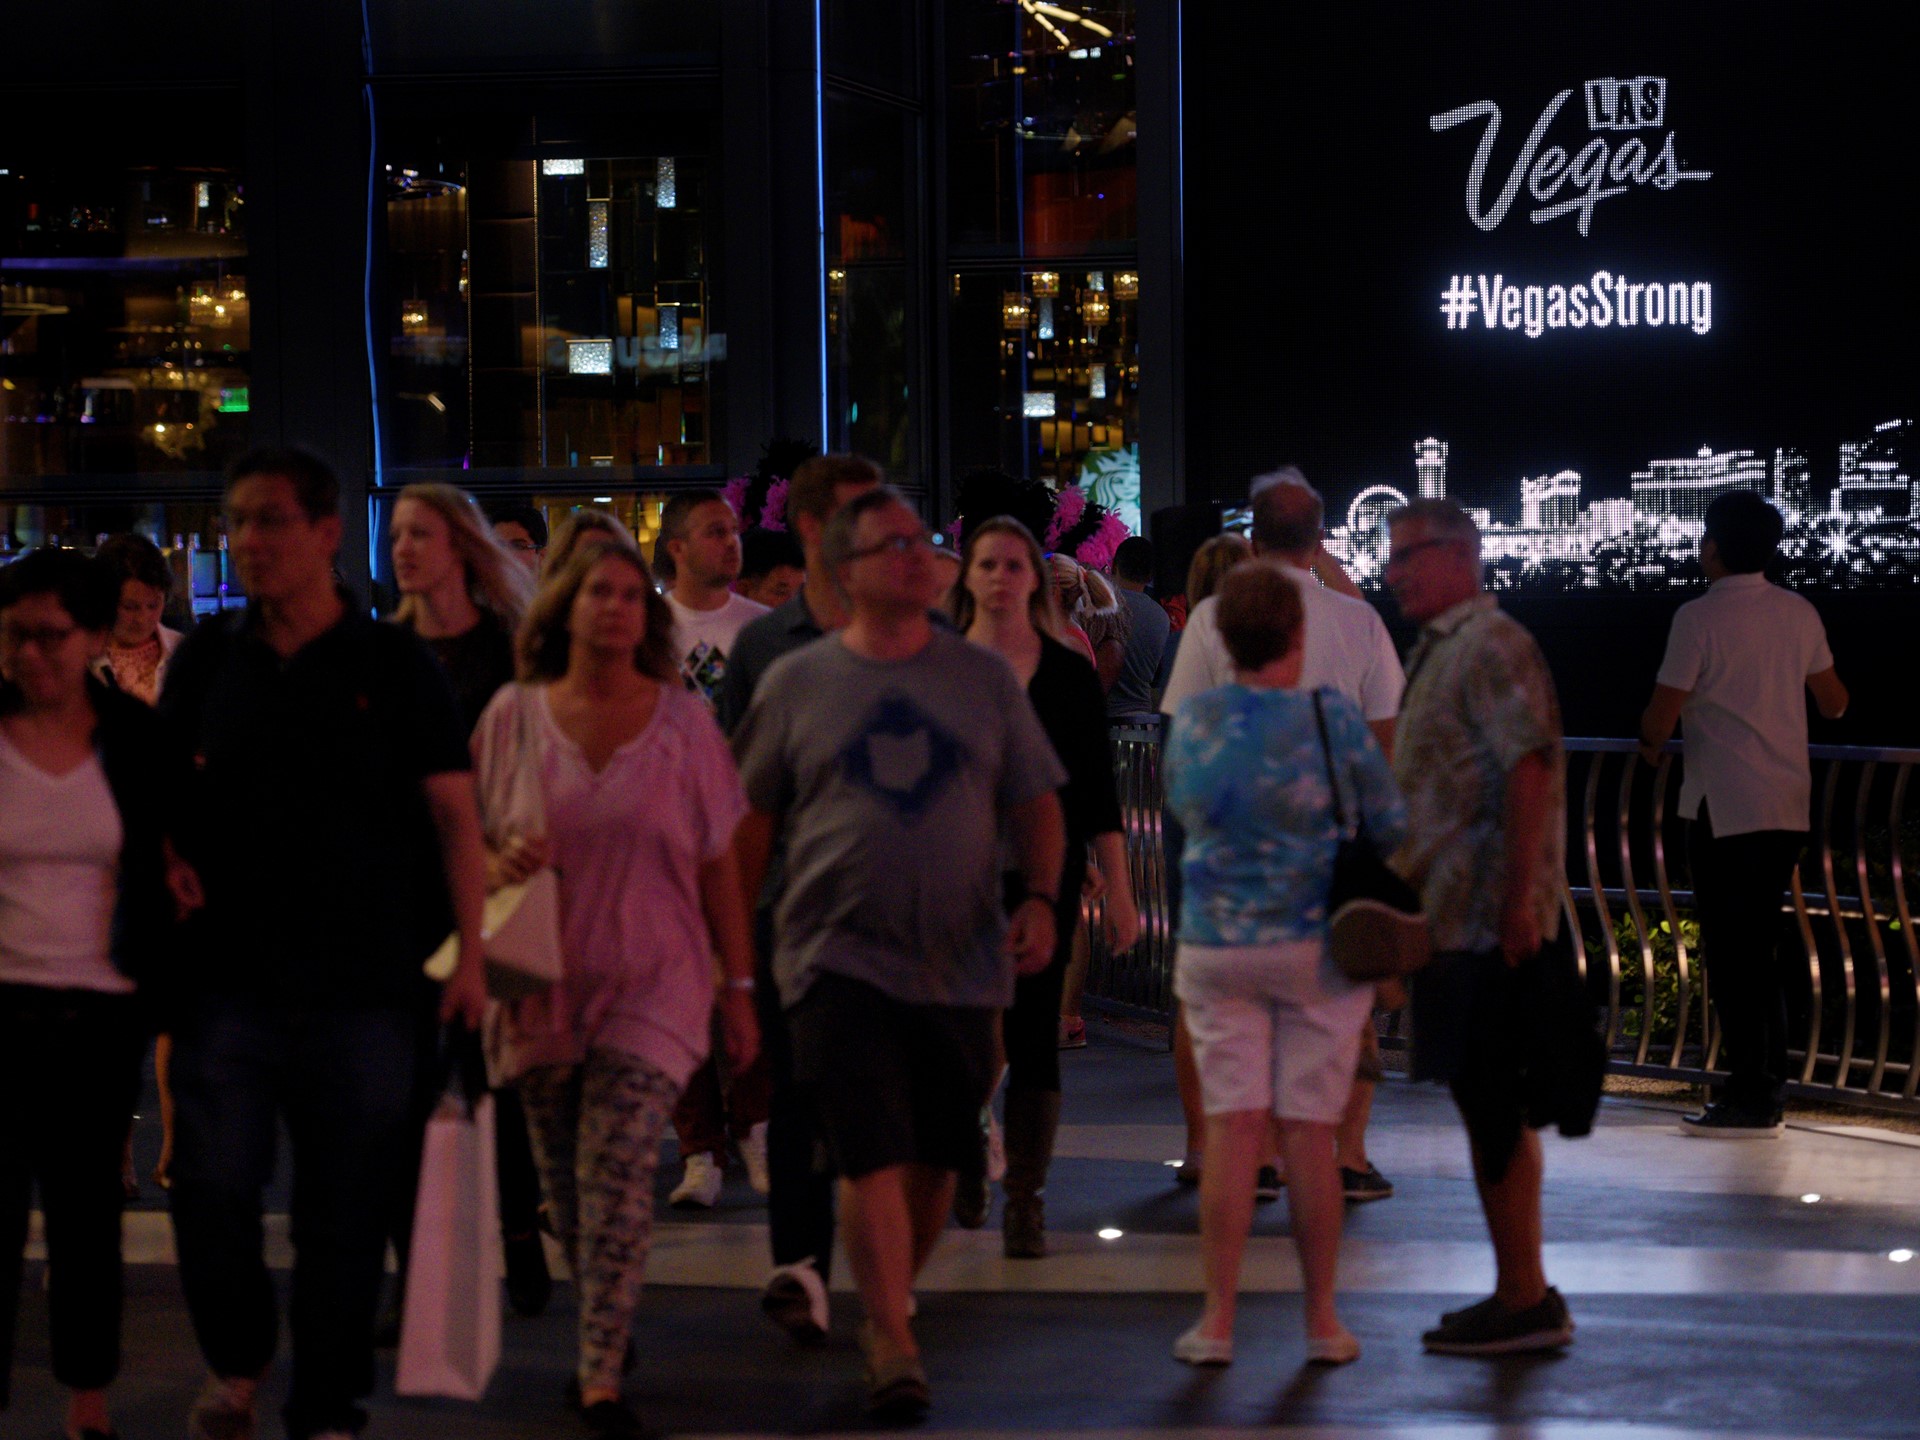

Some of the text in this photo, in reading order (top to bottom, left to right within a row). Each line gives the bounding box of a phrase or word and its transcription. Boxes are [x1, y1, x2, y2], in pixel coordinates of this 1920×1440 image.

[1591, 80, 1661, 126] LAS
[1430, 88, 1713, 236] Vegas
[1440, 270, 1711, 338] #VegasStrong
